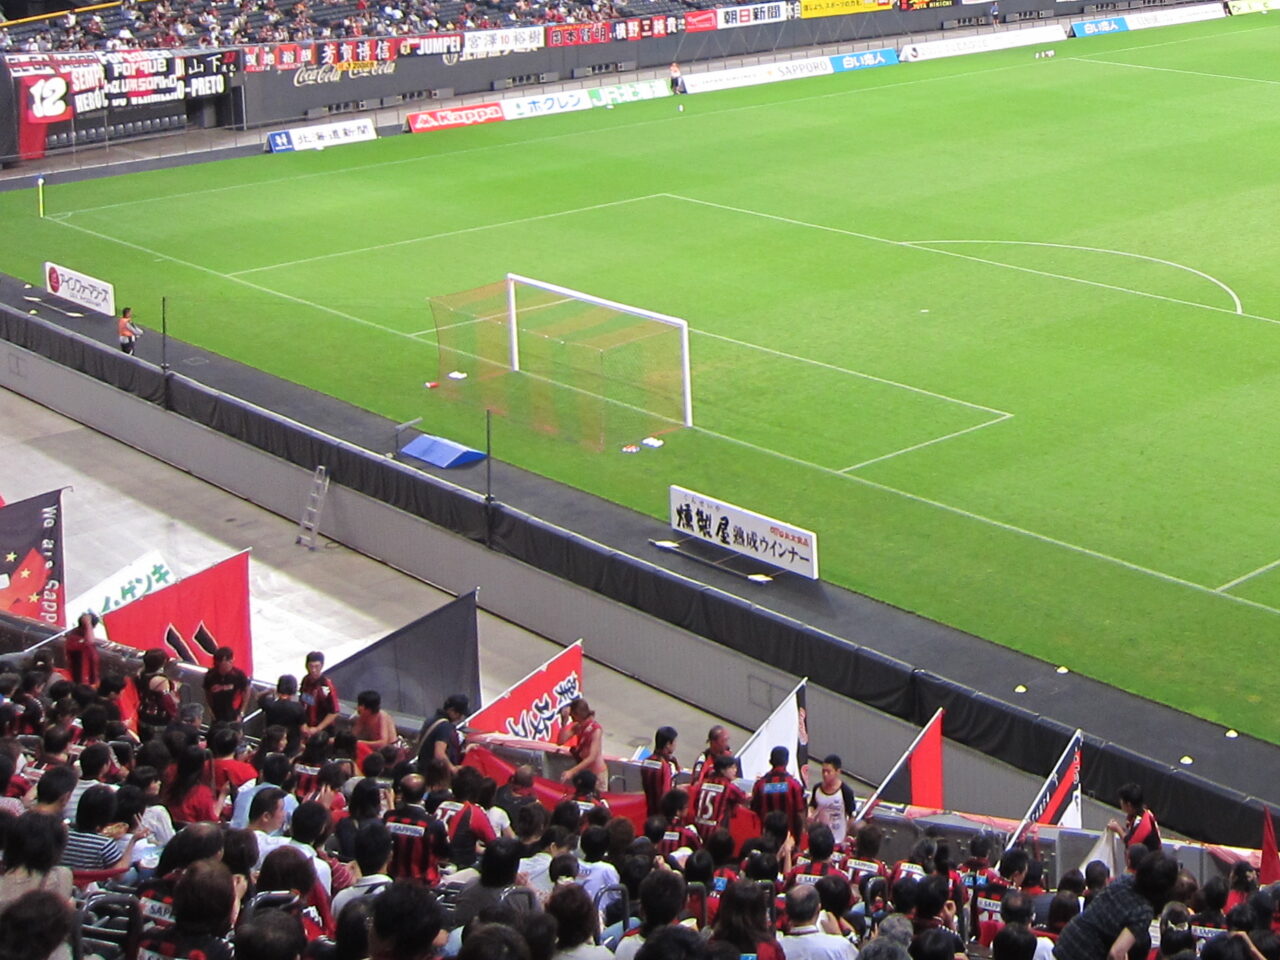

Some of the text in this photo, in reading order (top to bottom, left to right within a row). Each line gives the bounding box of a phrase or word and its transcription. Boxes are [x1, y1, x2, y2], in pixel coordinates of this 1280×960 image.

[723, 4, 781, 24] 朝日新聞
[416, 35, 461, 55] JUMPEI
[778, 59, 828, 78] SAPPORO
[842, 52, 886, 69] 白い恋人
[29, 76, 67, 118] 12
[528, 93, 582, 114] ホクレン
[438, 105, 502, 125] Kappa
[676, 503, 811, 564] 燻製屋 熟成ウインナー
